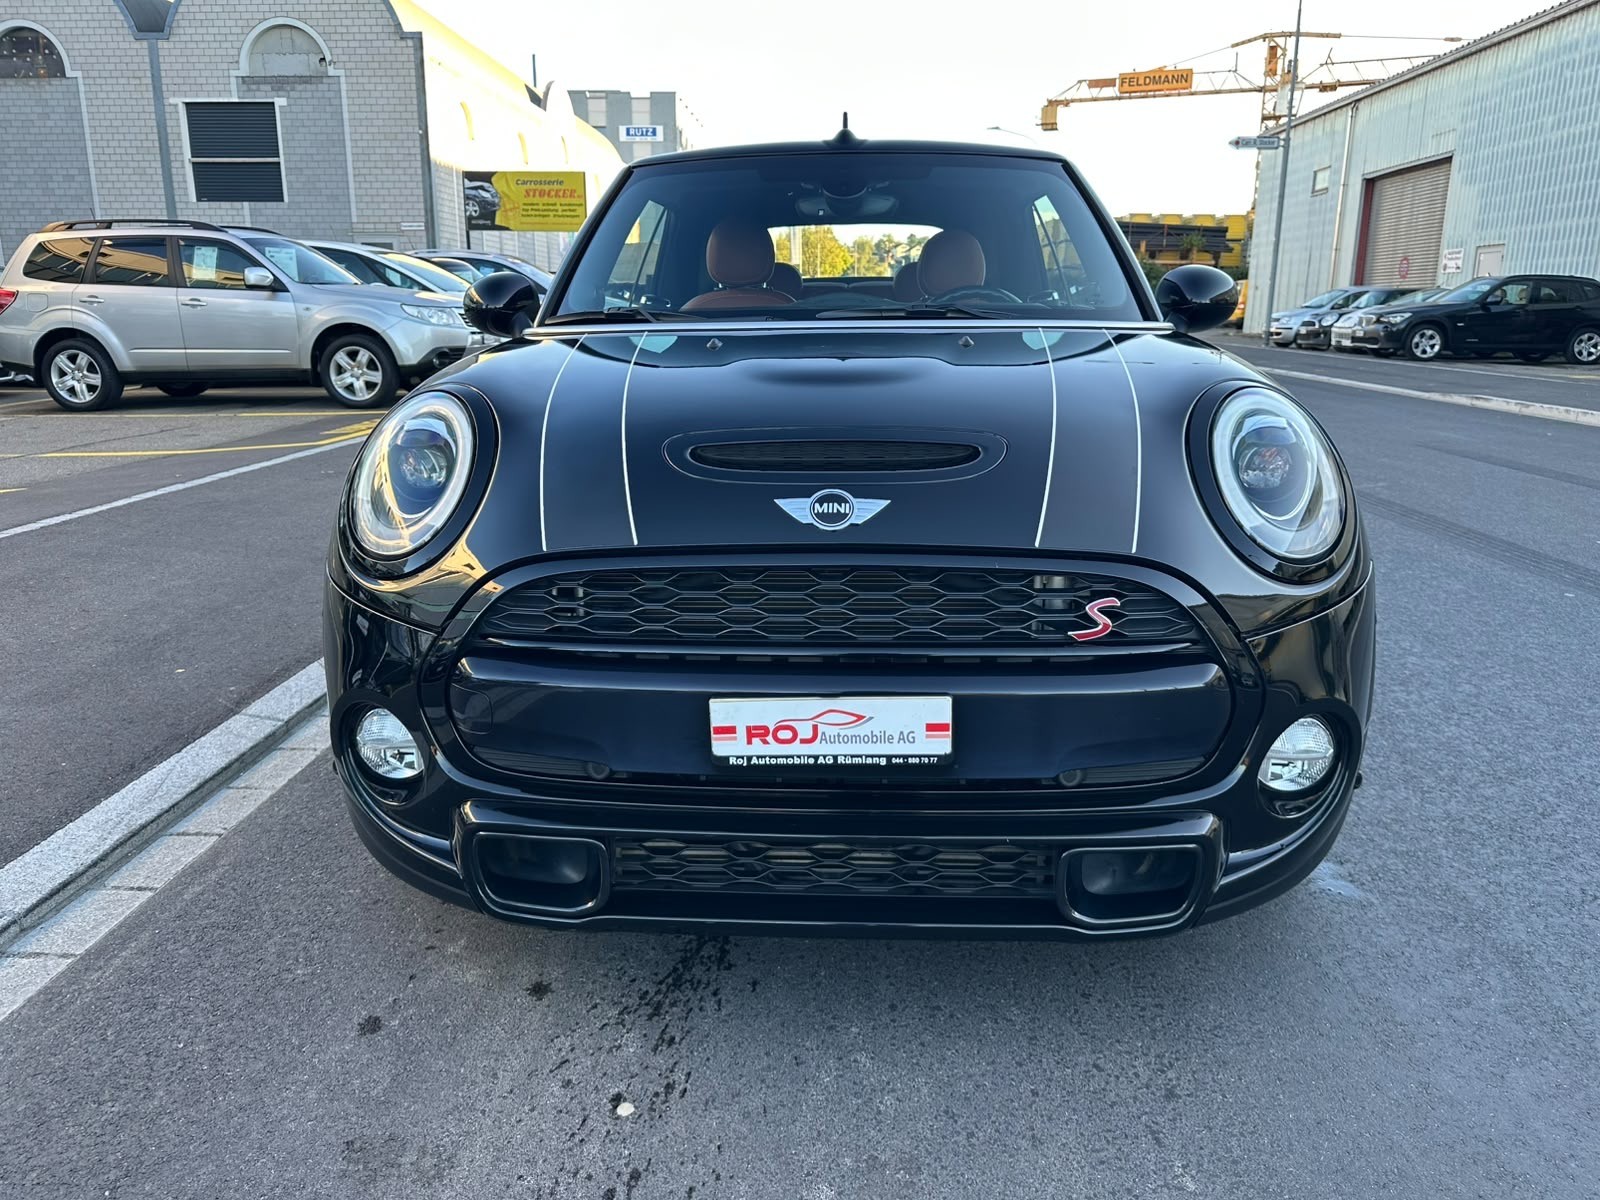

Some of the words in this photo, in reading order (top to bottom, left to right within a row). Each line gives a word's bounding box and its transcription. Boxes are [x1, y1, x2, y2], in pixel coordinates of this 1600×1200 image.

[1120, 73, 1189, 88] FELDMANN
[629, 128, 653, 136] RUTZ
[524, 188, 577, 199] STOCKER
[814, 502, 850, 514] MINI
[1067, 597, 1121, 641] S
[745, 724, 819, 745] ROJ
[819, 730, 894, 745] Automobile
[897, 730, 916, 745] AG
[729, 756, 748, 767] Roj
[750, 756, 815, 765] Automobile
[817, 756, 834, 765] AG
[837, 755, 887, 766] Rümlang
